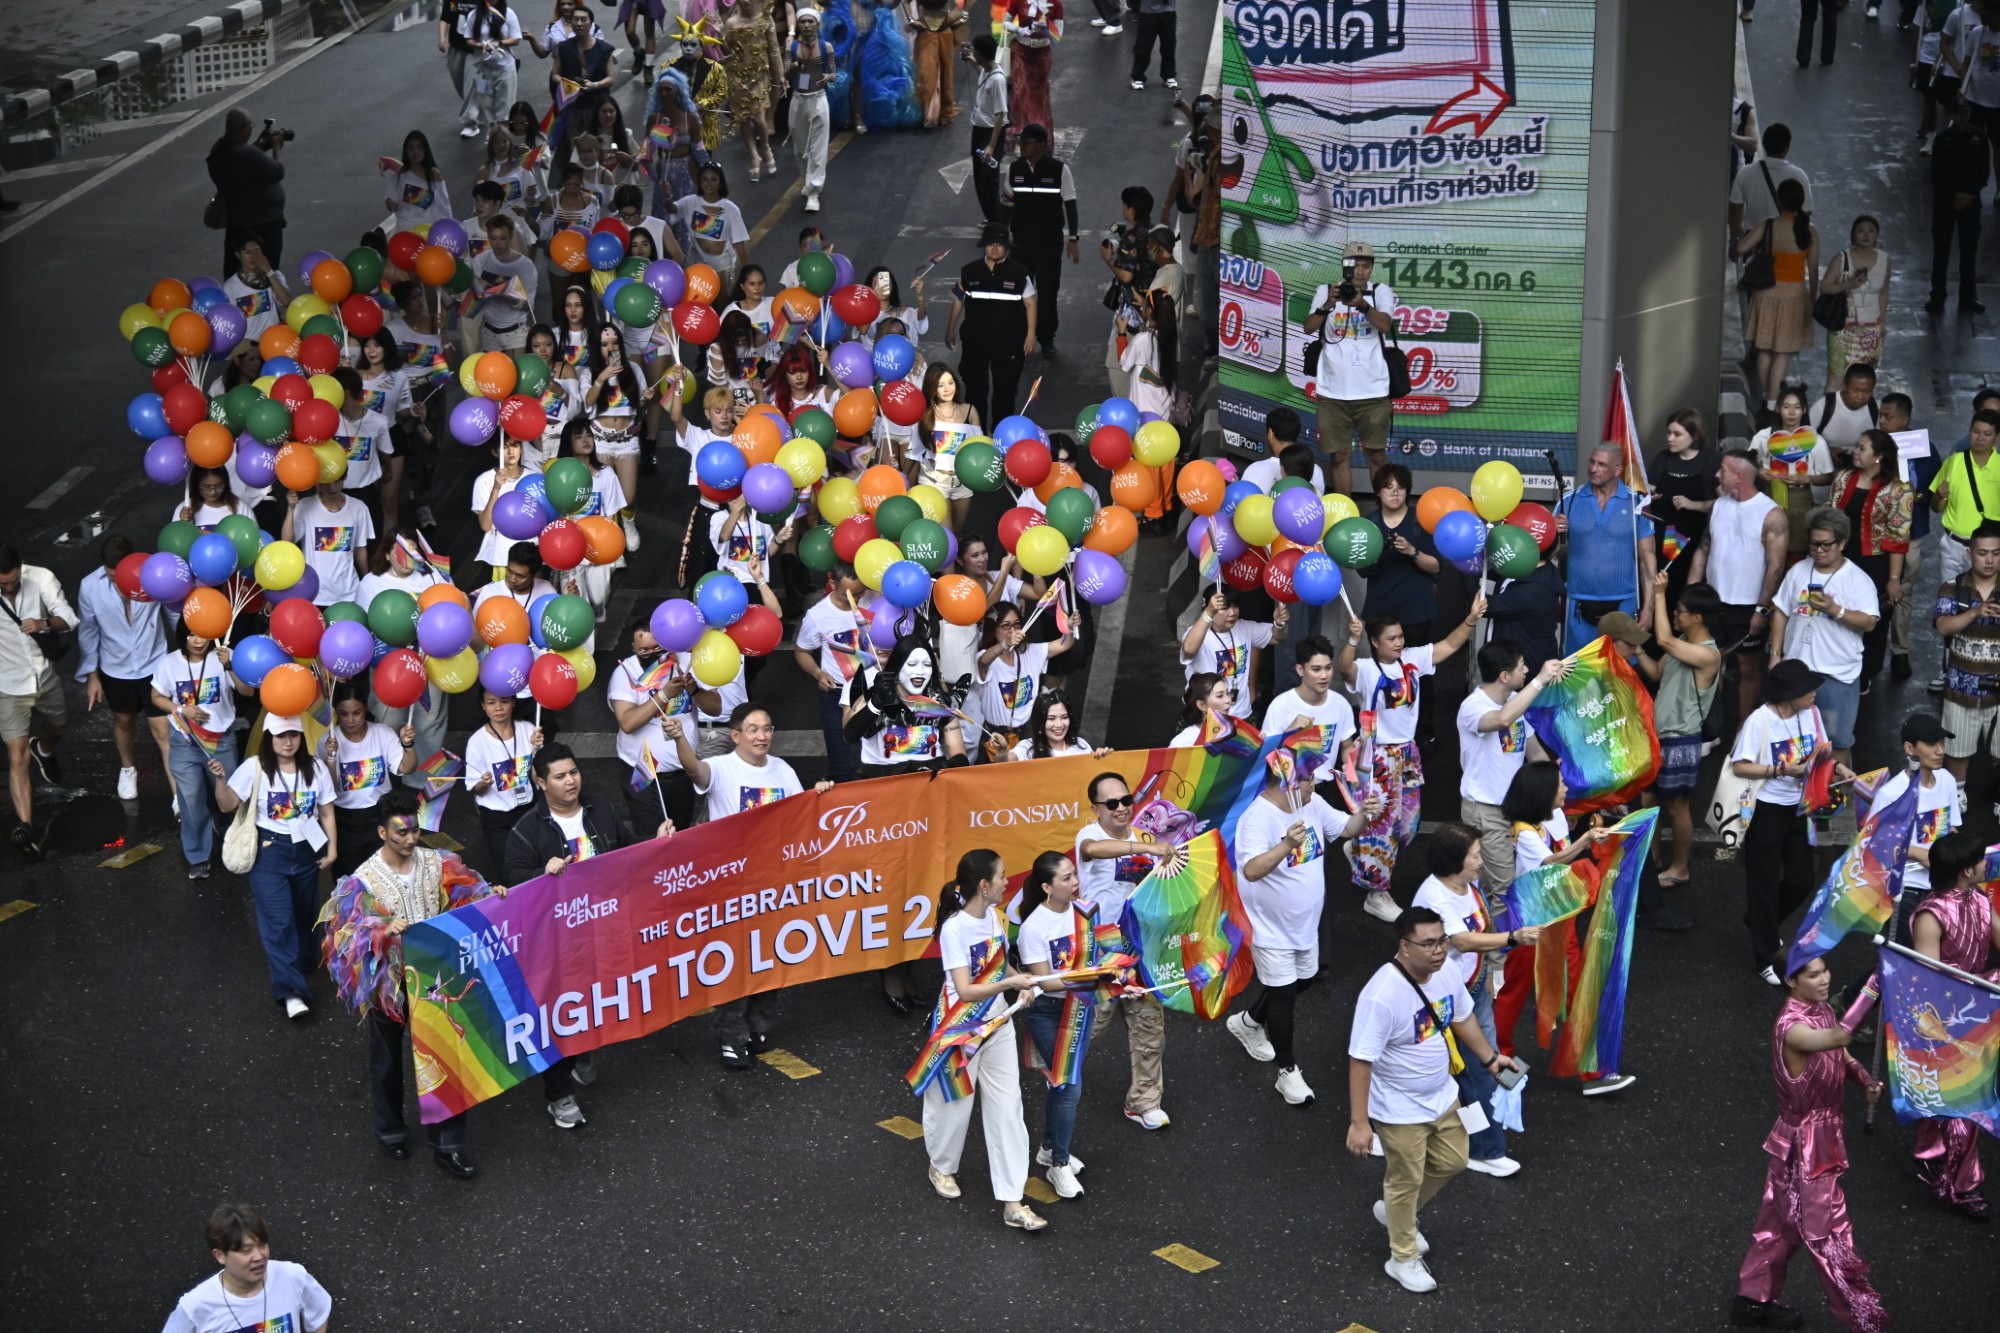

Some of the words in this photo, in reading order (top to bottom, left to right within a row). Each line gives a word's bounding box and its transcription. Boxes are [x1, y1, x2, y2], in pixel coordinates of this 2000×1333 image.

[437, 235, 458, 247] SIAM
[1387, 241, 1439, 255] Contact
[1444, 243, 1490, 256] Center
[691, 275, 713, 292] SIAM
[1381, 258, 1469, 290] 1443
[1520, 270, 1536, 291] 6
[213, 314, 236, 331] SIAM
[874, 351, 895, 363] SIAM
[895, 385, 916, 405] SIAM
[472, 415, 491, 437] SIAM
[1444, 443, 1476, 455] Bank
[1479, 443, 1491, 455] of
[984, 456, 1000, 479] SIAM
[1115, 479, 1138, 489] SIAM
[1179, 488, 1201, 501] SIAM
[862, 494, 887, 503] SIAM
[1292, 501, 1318, 521] SIAM
[907, 543, 932, 552] SIAM
[907, 550, 939, 560] PIWAT
[1348, 532, 1361, 565] PIWAT
[1357, 532, 1368, 560] SIAM
[1229, 568, 1256, 582] SIAM
[1306, 560, 1332, 574] SIAM
[543, 615, 568, 635] SIAM
[970, 802, 1080, 829] ICONSIAM
[783, 837, 823, 861] SIAM
[845, 817, 929, 848] PARAGON
[653, 861, 694, 885] SIAM
[662, 857, 748, 897] DISCOVERY
[554, 893, 590, 919] SIAM
[566, 898, 619, 929] CENTER
[640, 919, 669, 945] THE
[675, 869, 883, 940] CELEBRATION:
[458, 919, 510, 957] SIAM
[459, 932, 523, 975] PIWAT
[505, 963, 659, 1065] RIGHT
[669, 940, 735, 998] TO
[750, 904, 890, 975] LOVE
[1070, 1027, 1081, 1053] RIGHT
